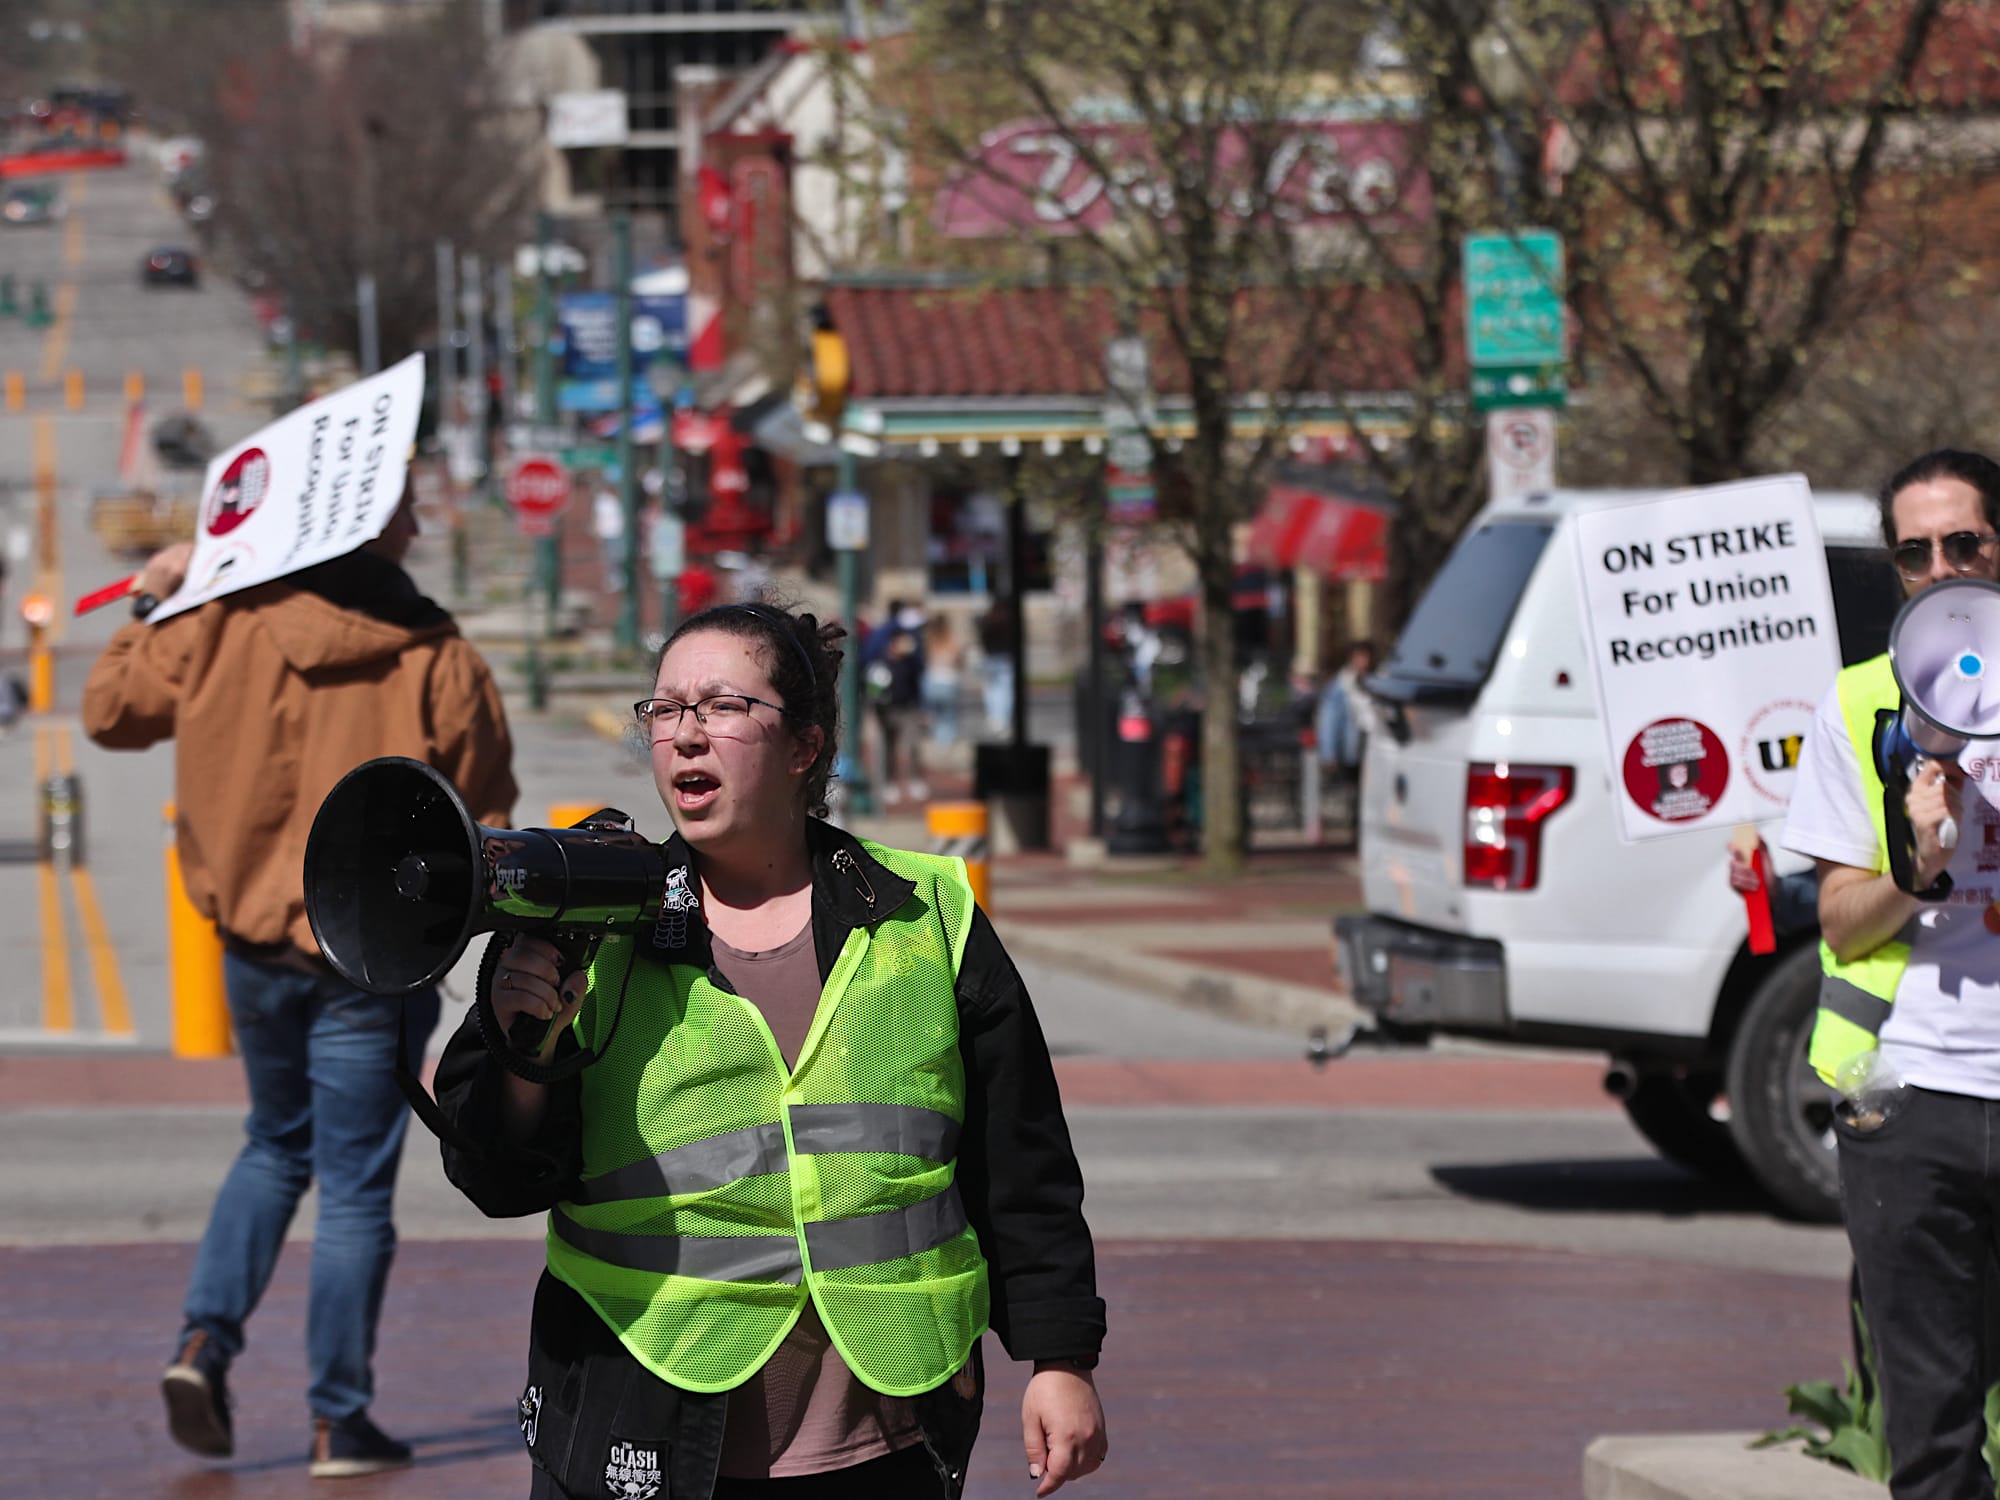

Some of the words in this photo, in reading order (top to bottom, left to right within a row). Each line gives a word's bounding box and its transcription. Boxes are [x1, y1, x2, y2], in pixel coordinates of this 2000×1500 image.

[1603, 543, 1654, 573] ON
[1667, 521, 1795, 564] STRIKE
[1623, 591, 1677, 617] For
[1690, 573, 1789, 606] Union
[1611, 615, 1817, 665] Recognition
[610, 1446, 657, 1470] CLASH
